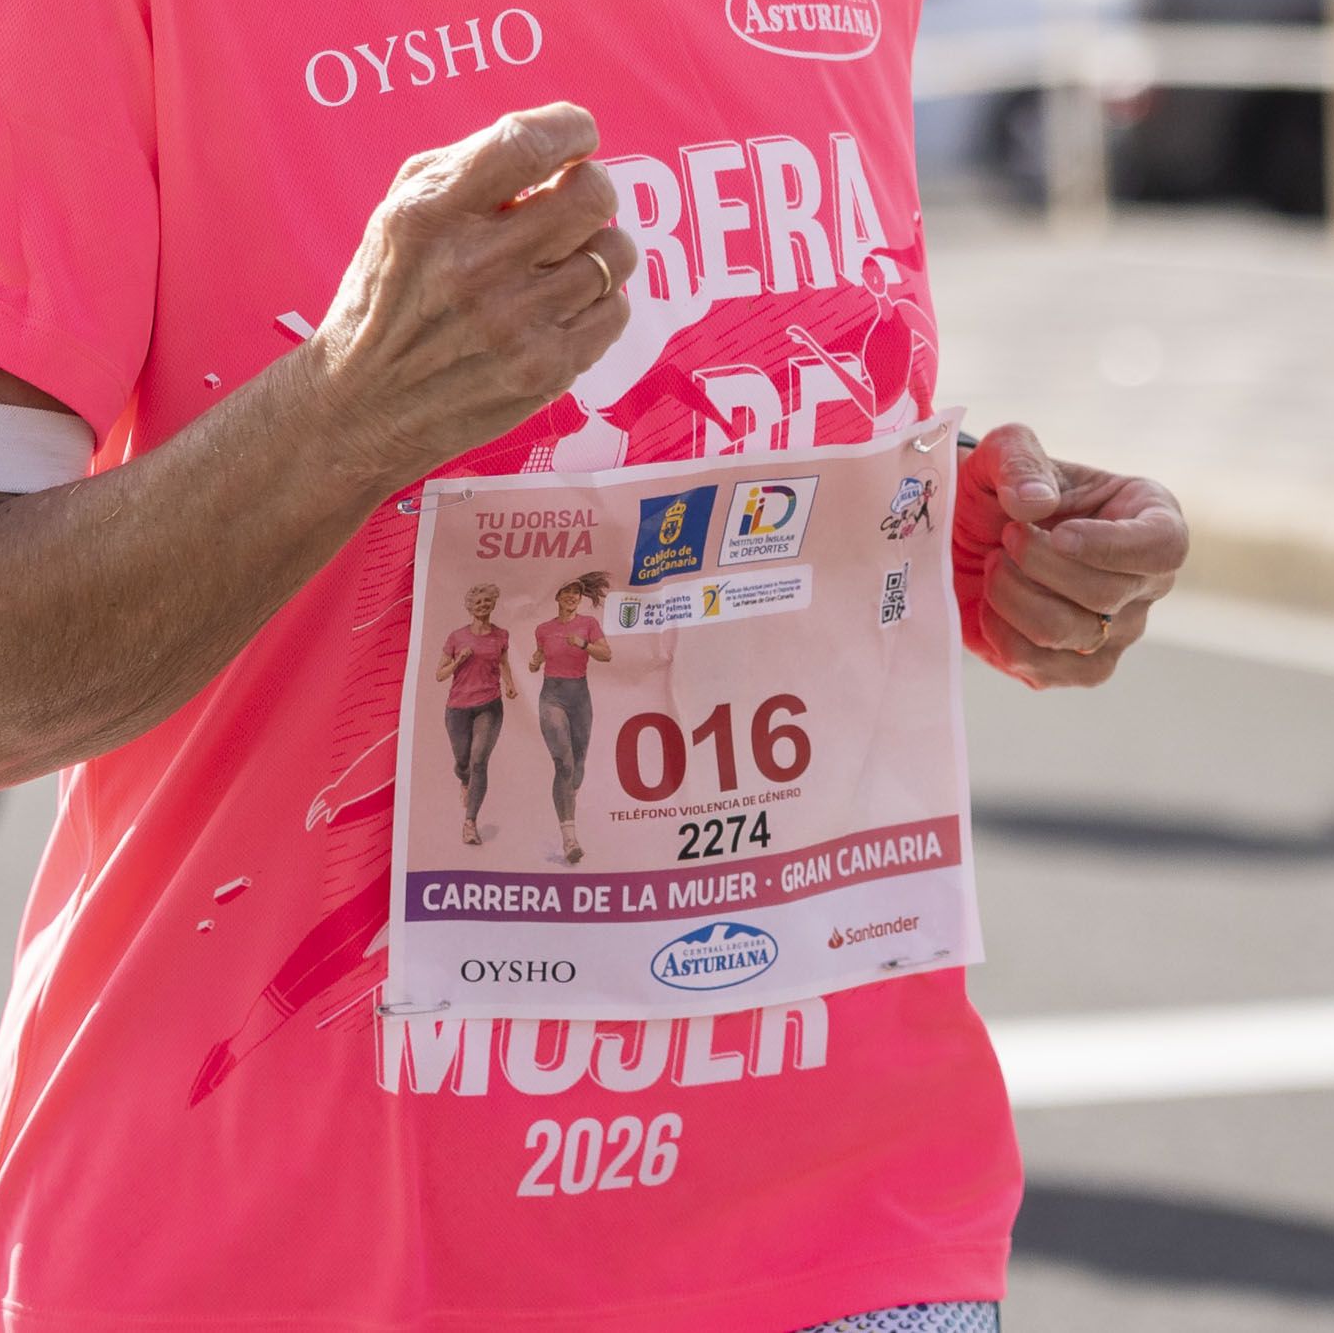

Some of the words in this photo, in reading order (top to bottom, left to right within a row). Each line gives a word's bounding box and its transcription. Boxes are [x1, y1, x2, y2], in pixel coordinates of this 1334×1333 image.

[305, 8, 543, 107] OYSHO
[592, 132, 902, 301] RERA
[475, 512, 505, 530] TU
[510, 509, 599, 529] DORSAL
[476, 530, 594, 560] SUMA
[740, 543, 790, 558] DEPORTES
[615, 693, 812, 802] 016
[609, 806, 677, 822] TELÉFONO
[679, 797, 740, 816] VIOLENCIA
[742, 795, 756, 808] DE
[758, 787, 801, 804] GÉNERO
[677, 810, 771, 861] 2274
[422, 882, 562, 912] CARRERA
[573, 885, 612, 913] DE
[622, 884, 658, 913] LA
[668, 871, 757, 909] MUJER
[781, 853, 832, 894] GRAN
[835, 830, 942, 871] CANARIA
[845, 915, 920, 946] Santander
[661, 948, 768, 978] ASTURIANA
[683, 946, 724, 957] CENTRAL
[460, 959, 576, 983] OYSHO
[516, 1112, 683, 1197] 2026
